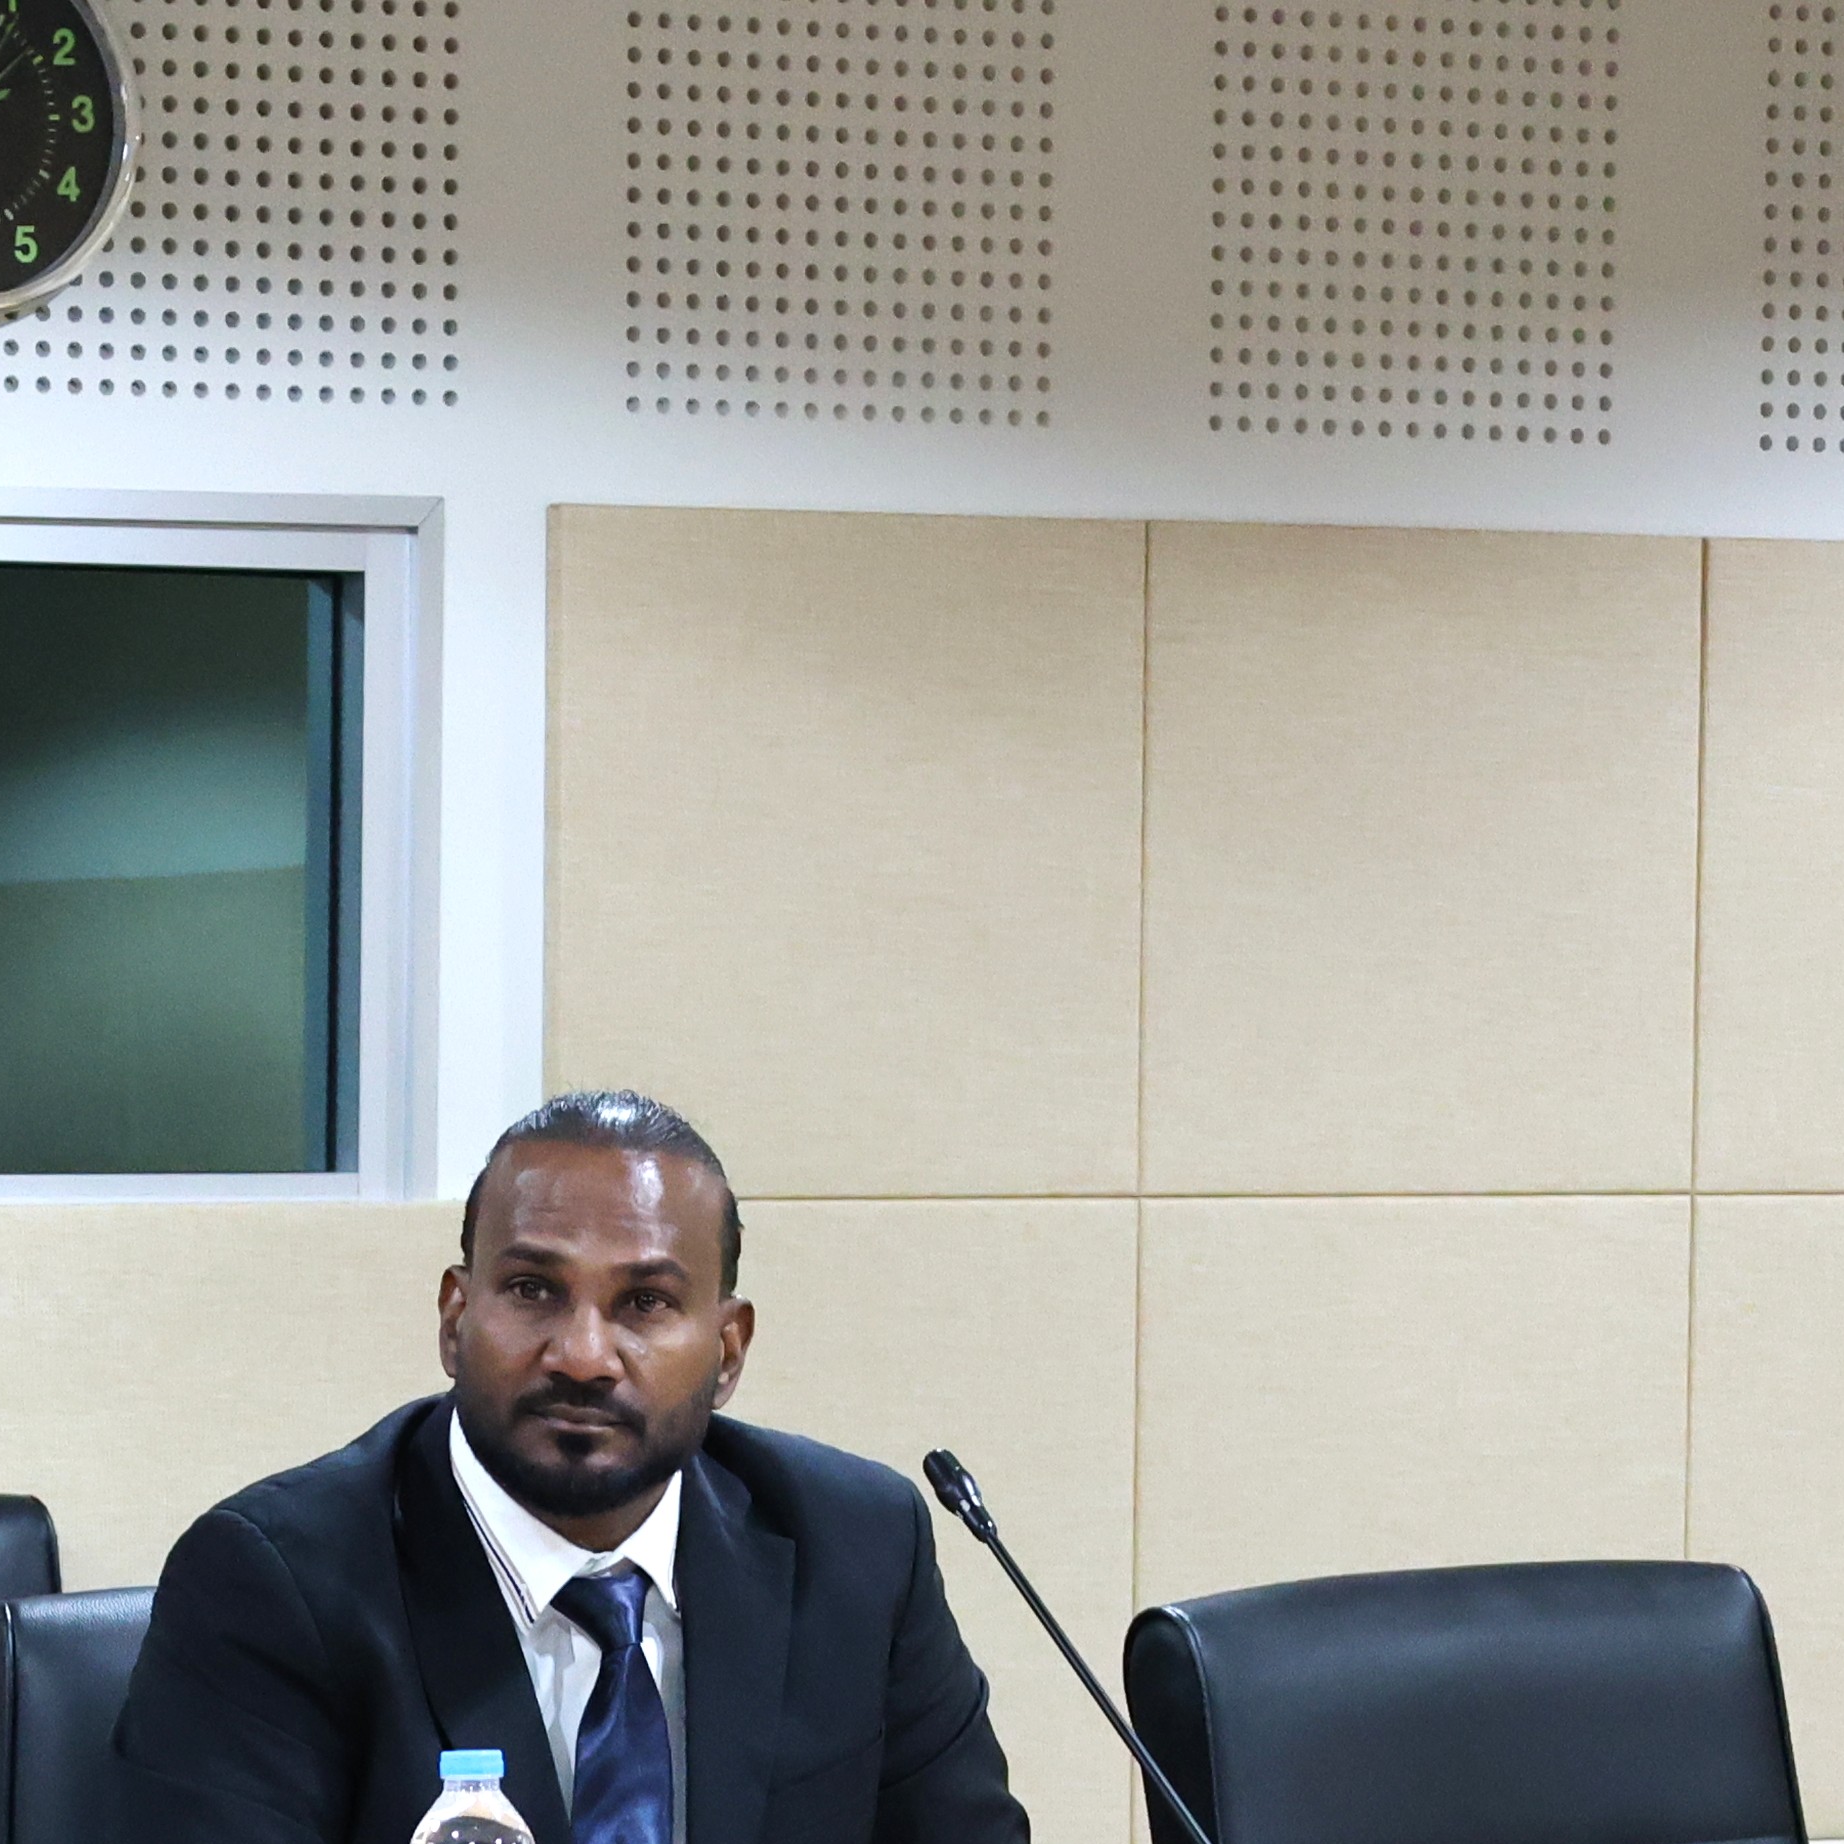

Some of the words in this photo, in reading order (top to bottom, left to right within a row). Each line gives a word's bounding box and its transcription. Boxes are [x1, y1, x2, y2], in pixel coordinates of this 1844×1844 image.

[54, 28, 75, 64] 2
[72, 96, 93, 131] 3
[57, 169, 80, 201] 4
[14, 226, 38, 263] 5
